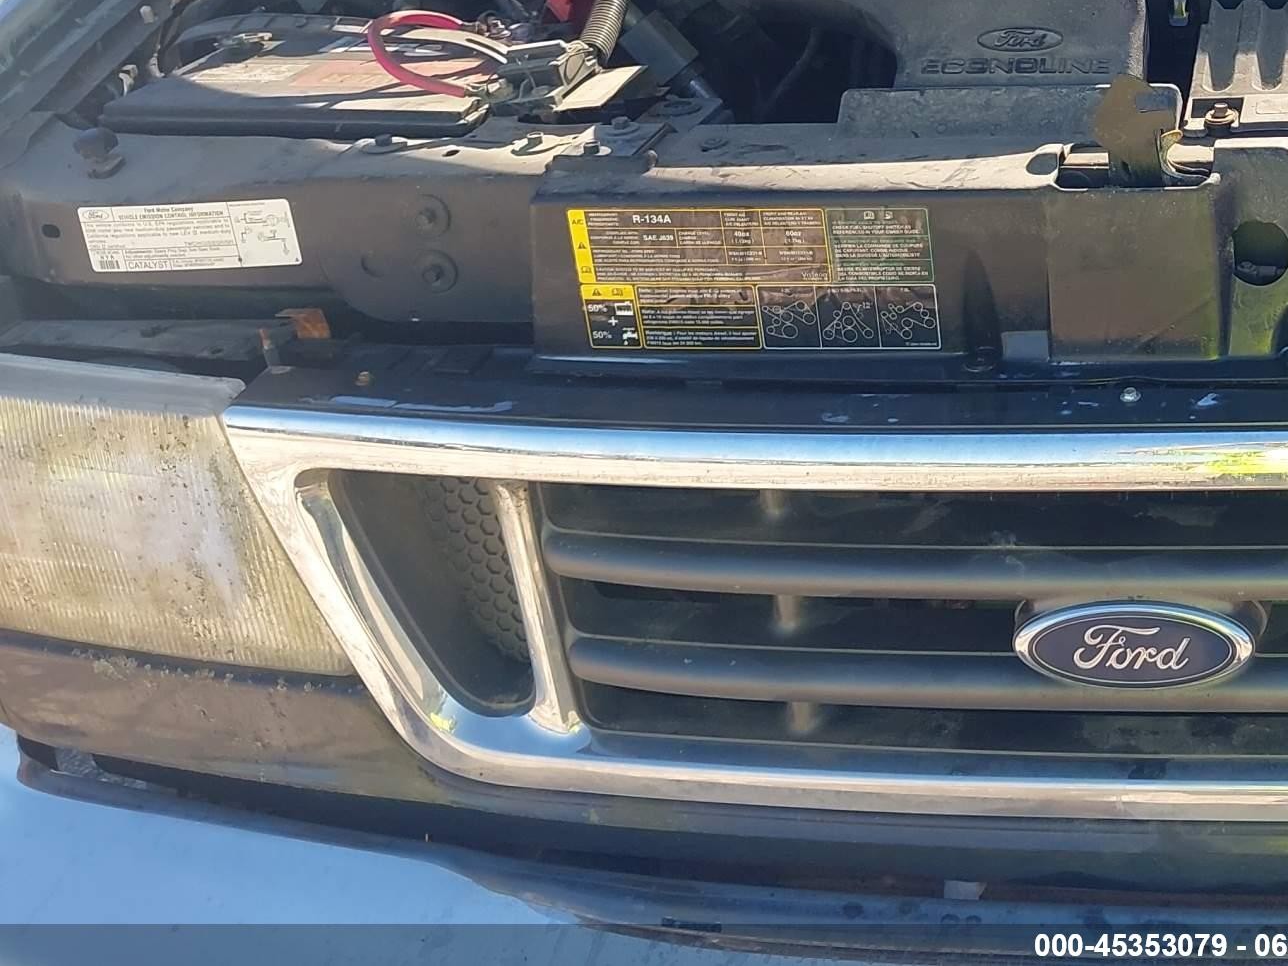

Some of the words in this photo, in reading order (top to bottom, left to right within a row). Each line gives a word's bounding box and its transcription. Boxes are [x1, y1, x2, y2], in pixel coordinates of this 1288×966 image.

[993, 29, 1047, 49] Ford
[920, 57, 1111, 75] ECONOLINE
[632, 214, 672, 224] R-134A
[128, 260, 168, 270] CATALYST
[587, 304, 608, 313] 50%
[592, 331, 612, 339] 50%
[1073, 624, 1191, 670] Ford
